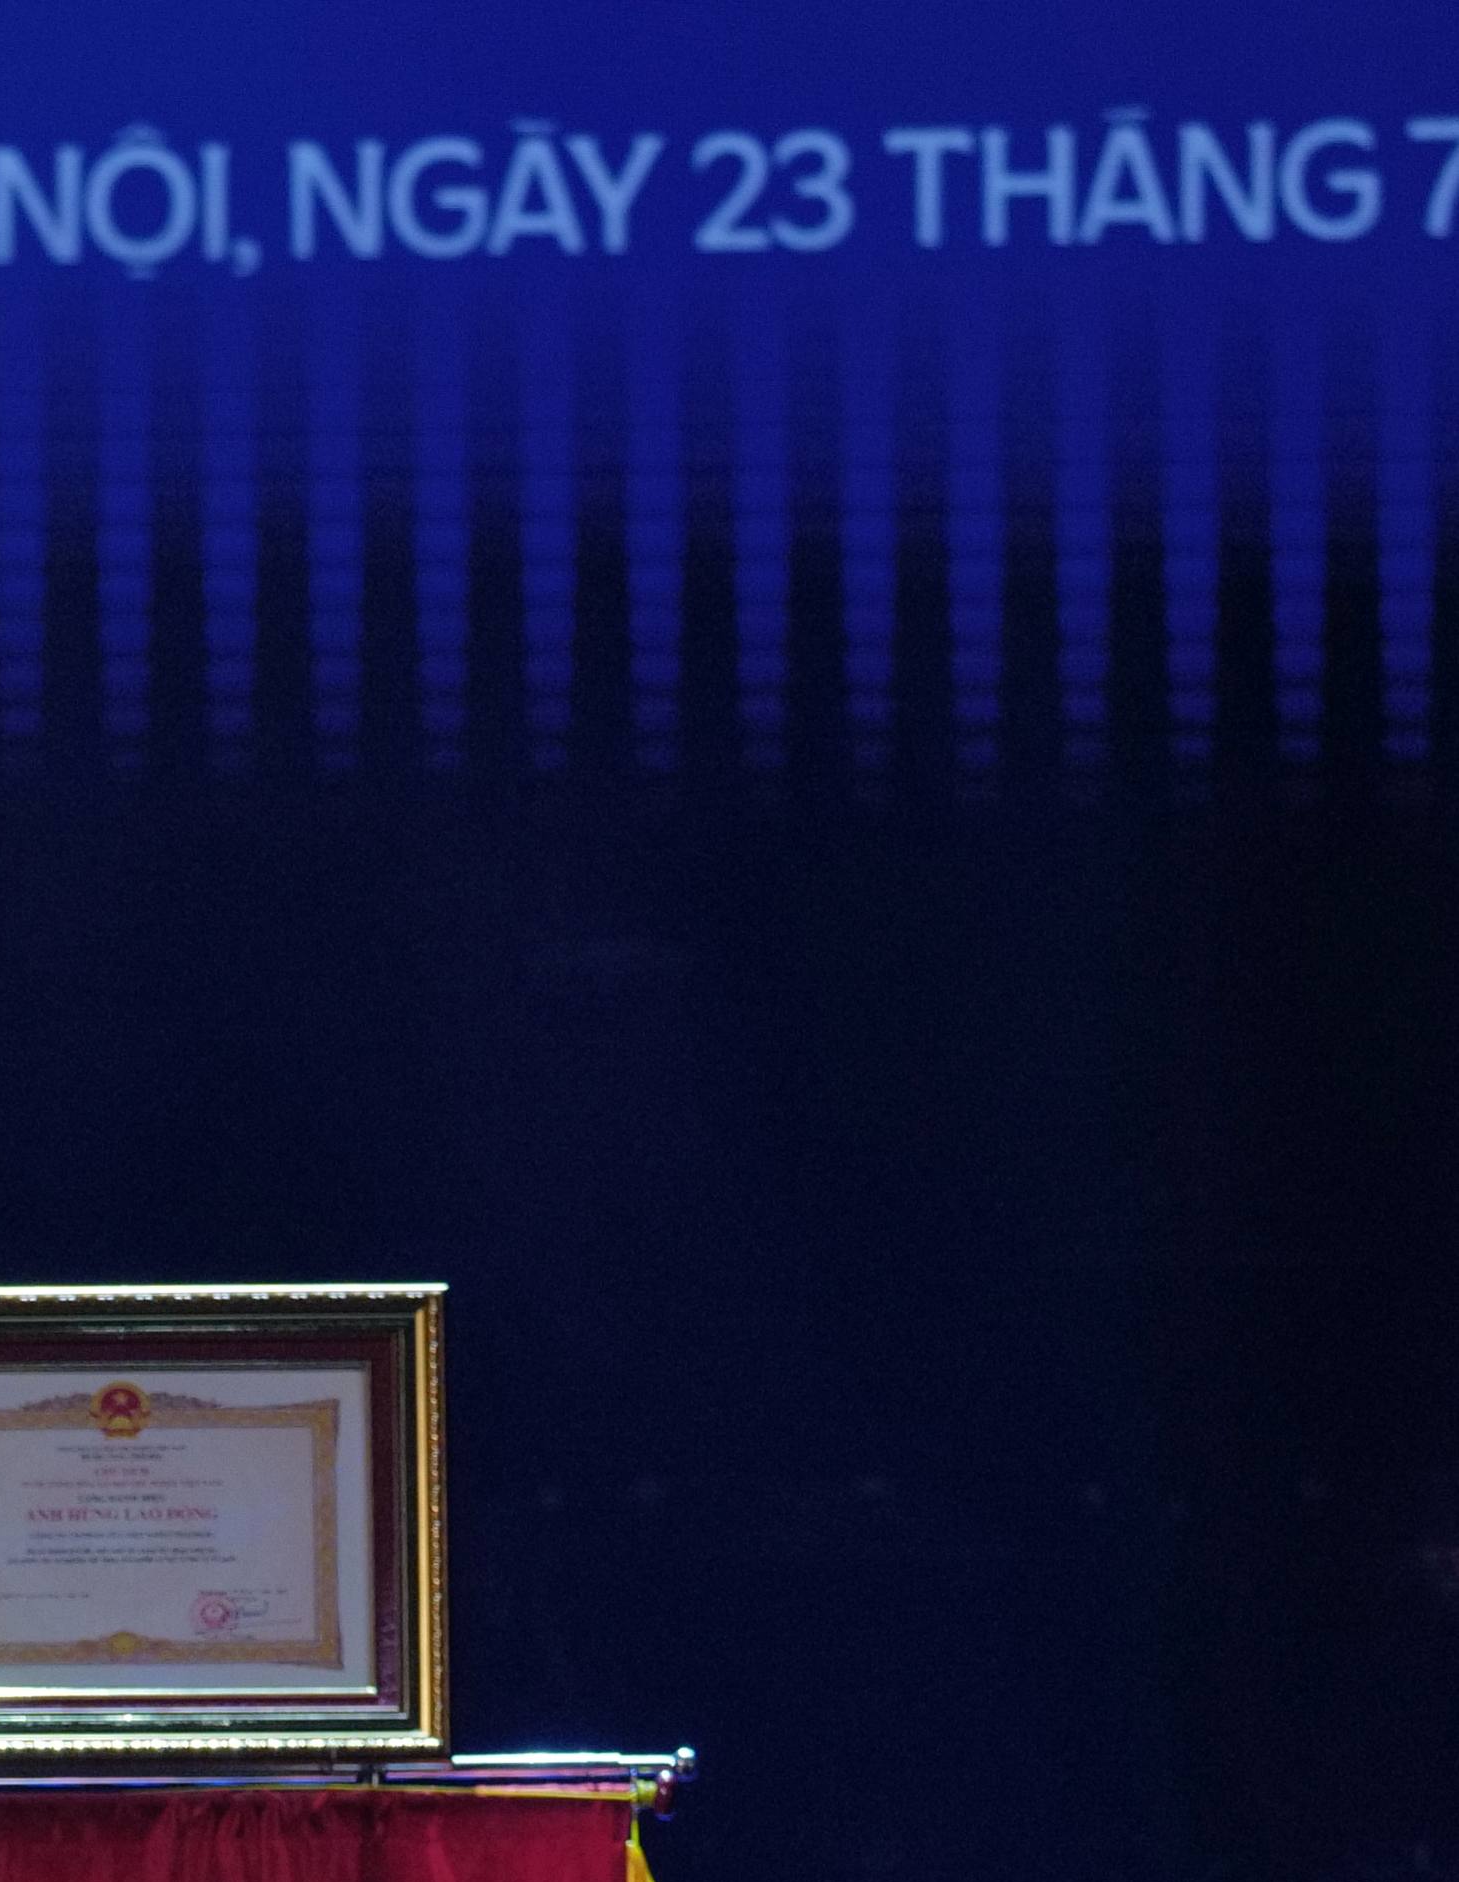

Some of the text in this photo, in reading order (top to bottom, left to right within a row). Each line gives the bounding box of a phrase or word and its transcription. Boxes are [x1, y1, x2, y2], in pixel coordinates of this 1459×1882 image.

[287, 117, 664, 261] NGÀY
[690, 129, 854, 252] 23
[882, 104, 1383, 248] THÁNG
